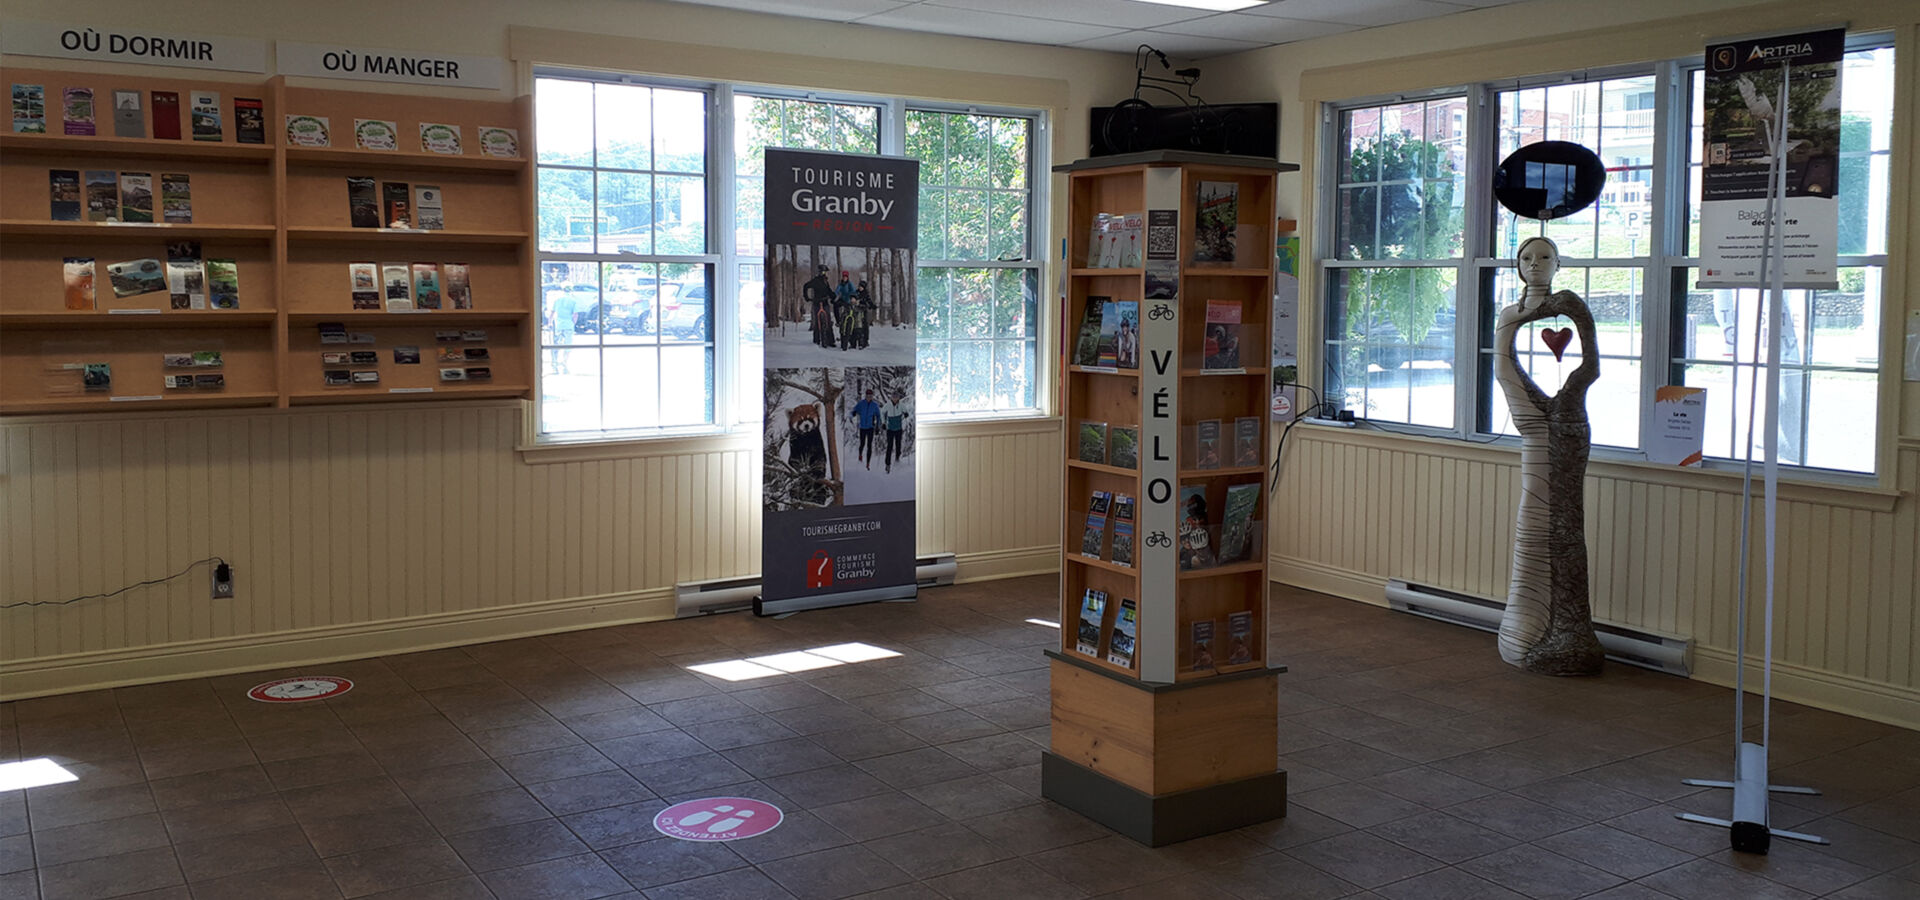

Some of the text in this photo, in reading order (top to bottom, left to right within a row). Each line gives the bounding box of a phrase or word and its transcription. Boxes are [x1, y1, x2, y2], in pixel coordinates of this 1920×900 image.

[60, 28, 213, 61] OÙ DORMIR
[1748, 42, 1813, 58] ARTRIA
[323, 50, 459, 79] OÙ MANGER
[792, 167, 894, 189] TOURISME
[791, 188, 894, 221] Granby
[1629, 212, 1638, 226] P
[1148, 350, 1172, 504] VÉLO
[802, 521, 881, 537] TOURISMEGRANBY.COM
[837, 553, 875, 563] COMMERCE
[837, 560, 875, 570] TOURISME
[836, 566, 875, 580] Granby
